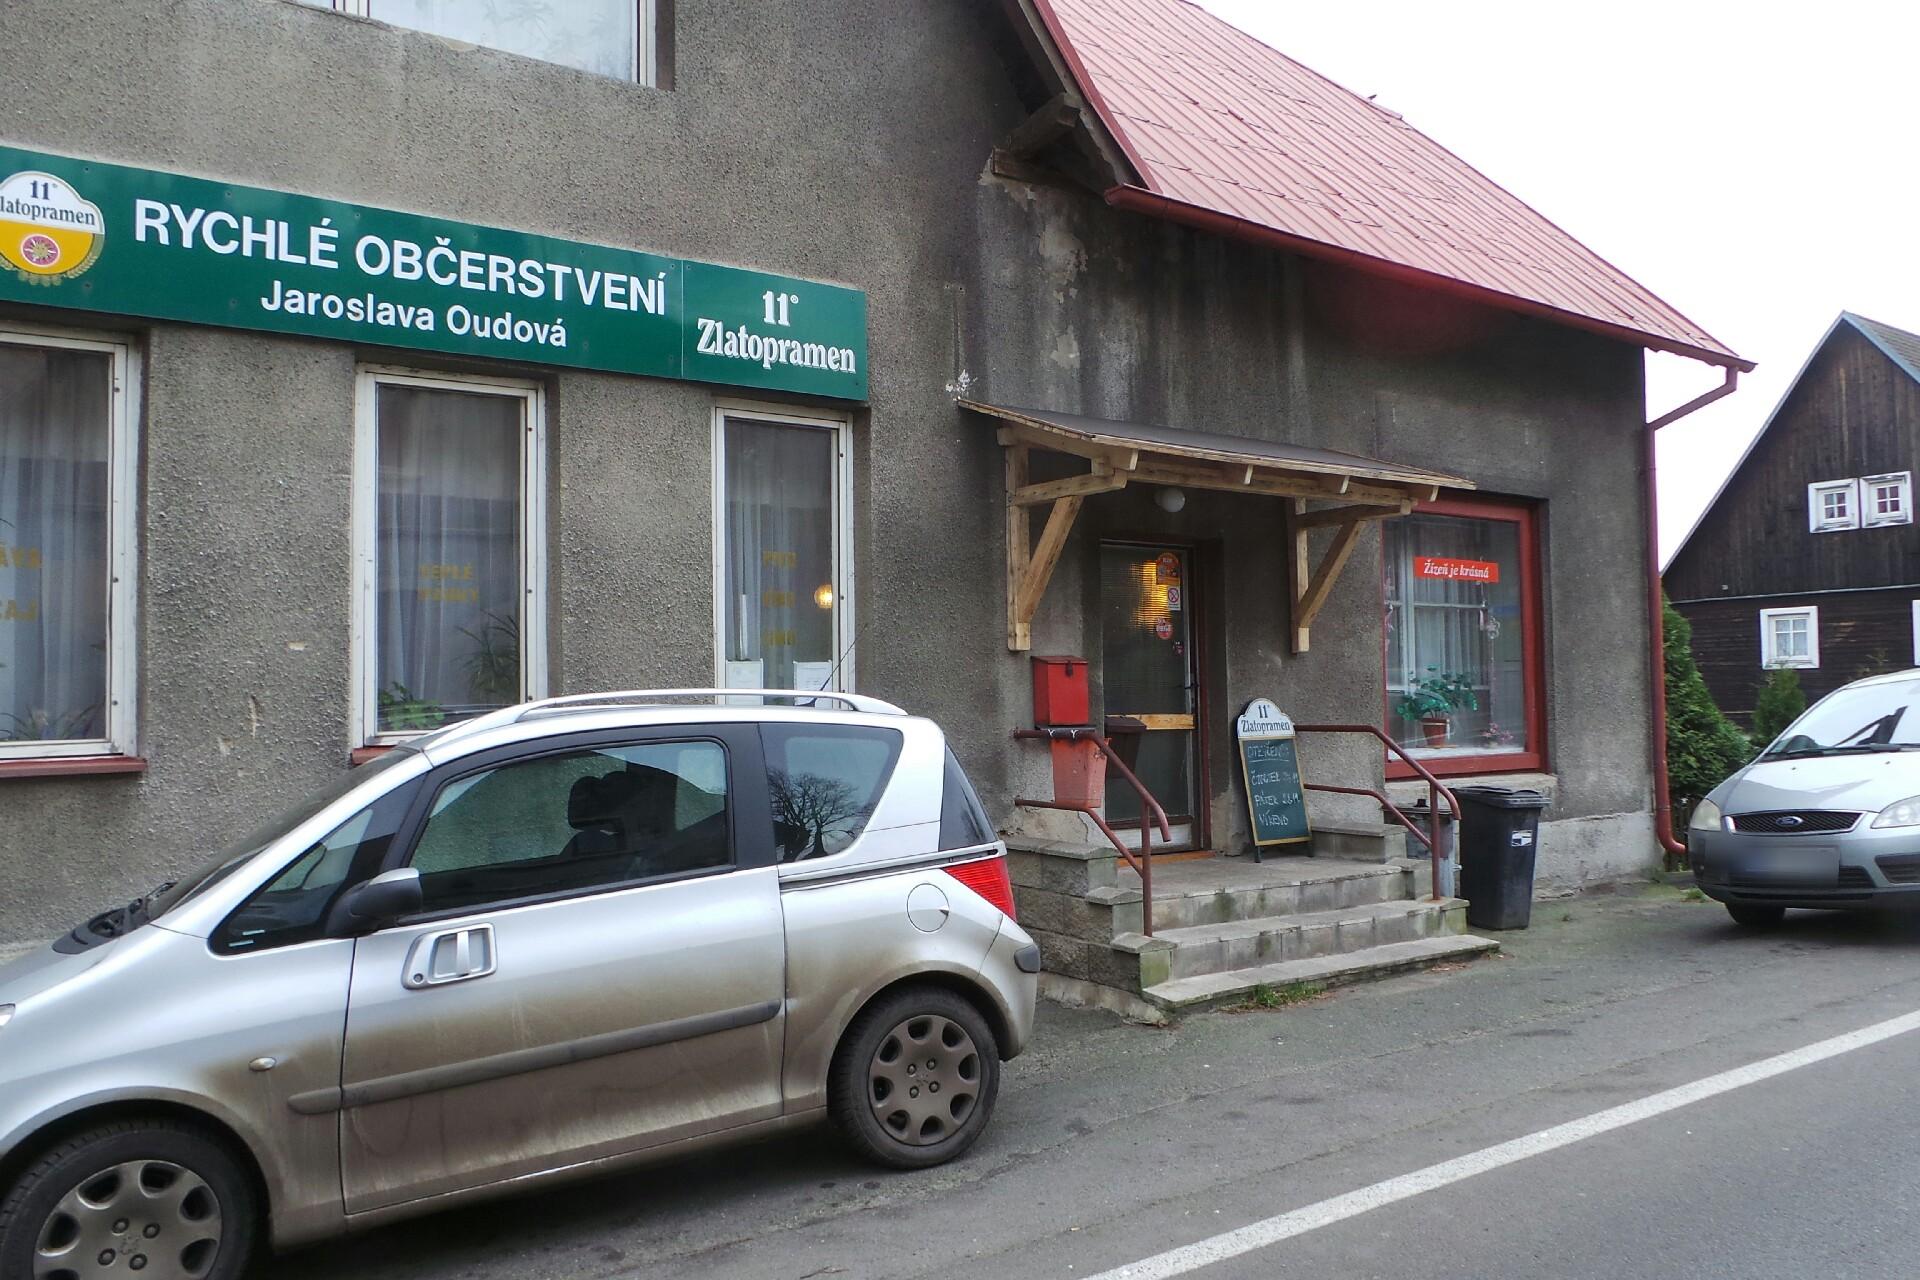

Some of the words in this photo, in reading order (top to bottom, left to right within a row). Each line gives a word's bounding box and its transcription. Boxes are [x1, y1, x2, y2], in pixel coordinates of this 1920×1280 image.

[135, 199, 339, 269] RYCHLÉ
[355, 235, 665, 315] OBČERSTVENÍ
[261, 280, 435, 332] Jaroslava
[446, 304, 567, 347] Oudová
[697, 318, 857, 374] Zlatopramen
[1448, 564, 1458, 578] je
[1460, 564, 1489, 579] krásná
[1241, 719, 1291, 734] Zlatopramen
